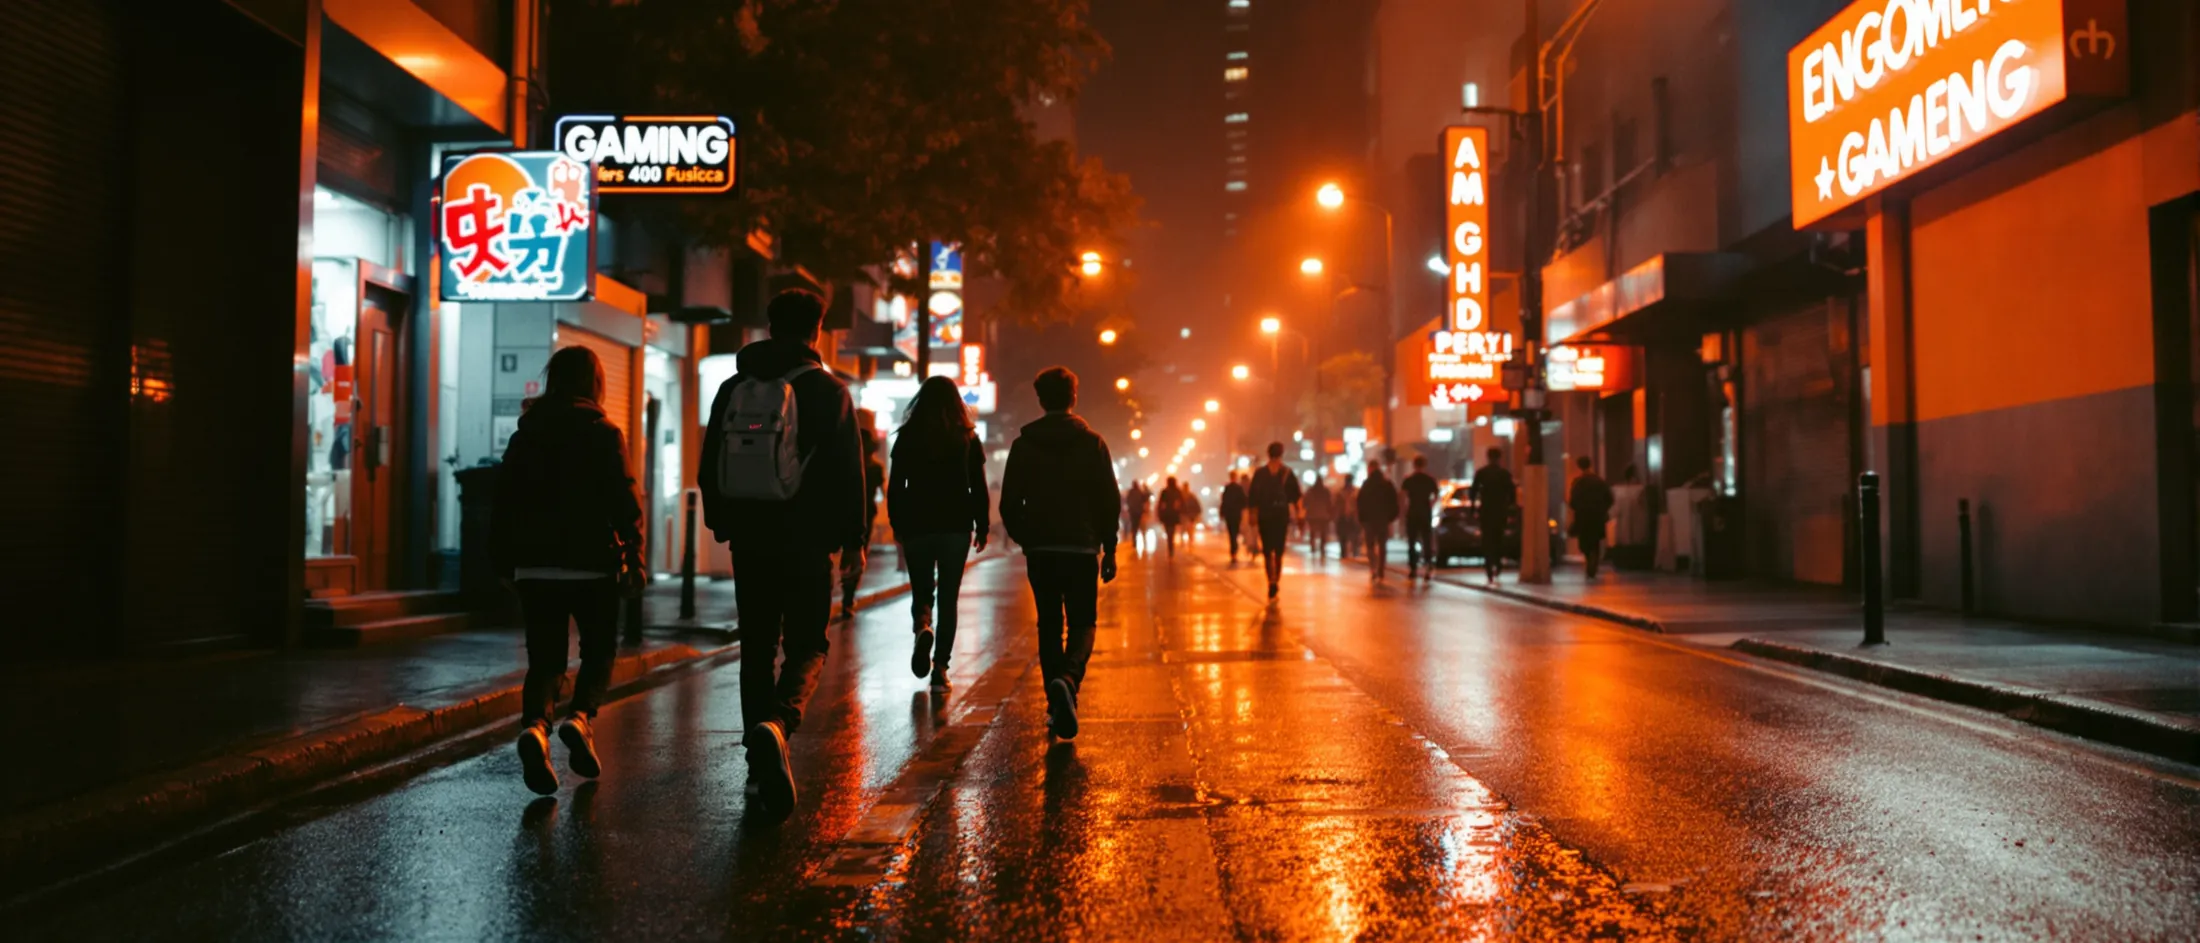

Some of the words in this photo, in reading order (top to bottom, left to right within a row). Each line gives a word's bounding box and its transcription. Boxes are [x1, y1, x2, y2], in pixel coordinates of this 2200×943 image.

[1838, 39, 2031, 196] GAMENG
[565, 125, 729, 165] GAMING
[628, 165, 661, 184] 400
[665, 166, 724, 183] Fusicca
